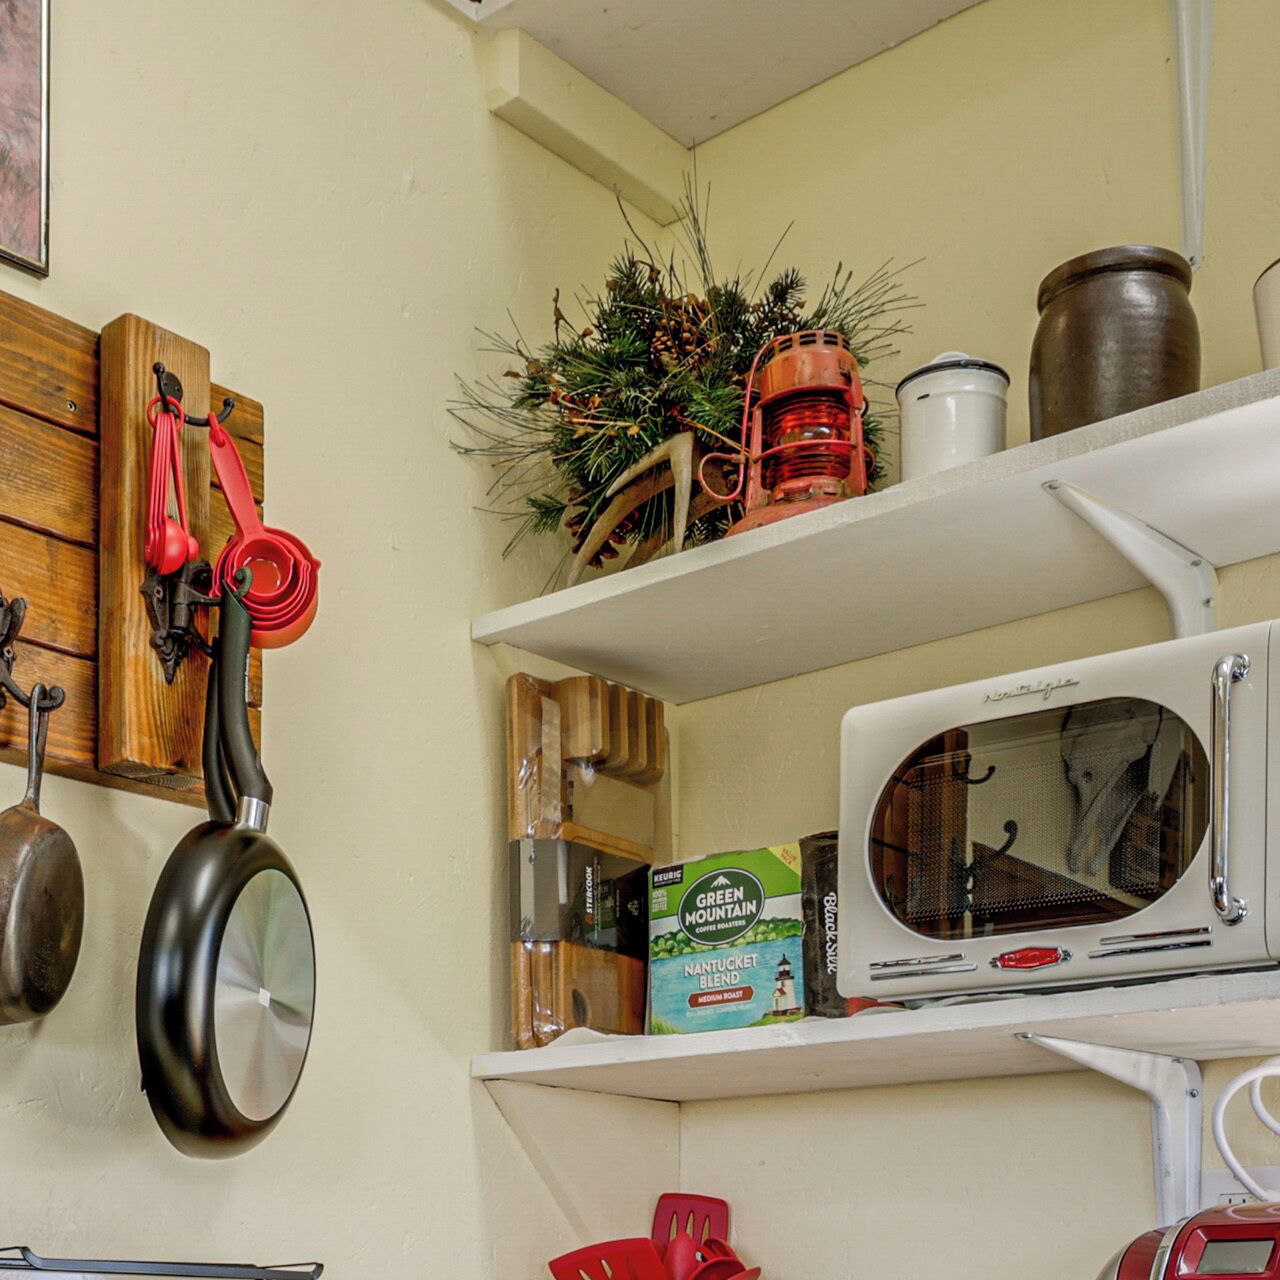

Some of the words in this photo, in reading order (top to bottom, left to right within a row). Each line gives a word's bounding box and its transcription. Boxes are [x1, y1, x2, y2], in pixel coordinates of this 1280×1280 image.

[654, 870, 682, 882] KEURIG
[696, 886, 744, 908] GREEN
[685, 900, 757, 926] MOUNTAIN
[695, 925, 716, 934] COFFEE
[718, 919, 746, 930] ROASTERS
[684, 953, 759, 977] NANTUCKET
[700, 971, 740, 989] BLEND
[698, 993, 723, 1004] MEDIUM
[723, 990, 744, 1001] ROAST
